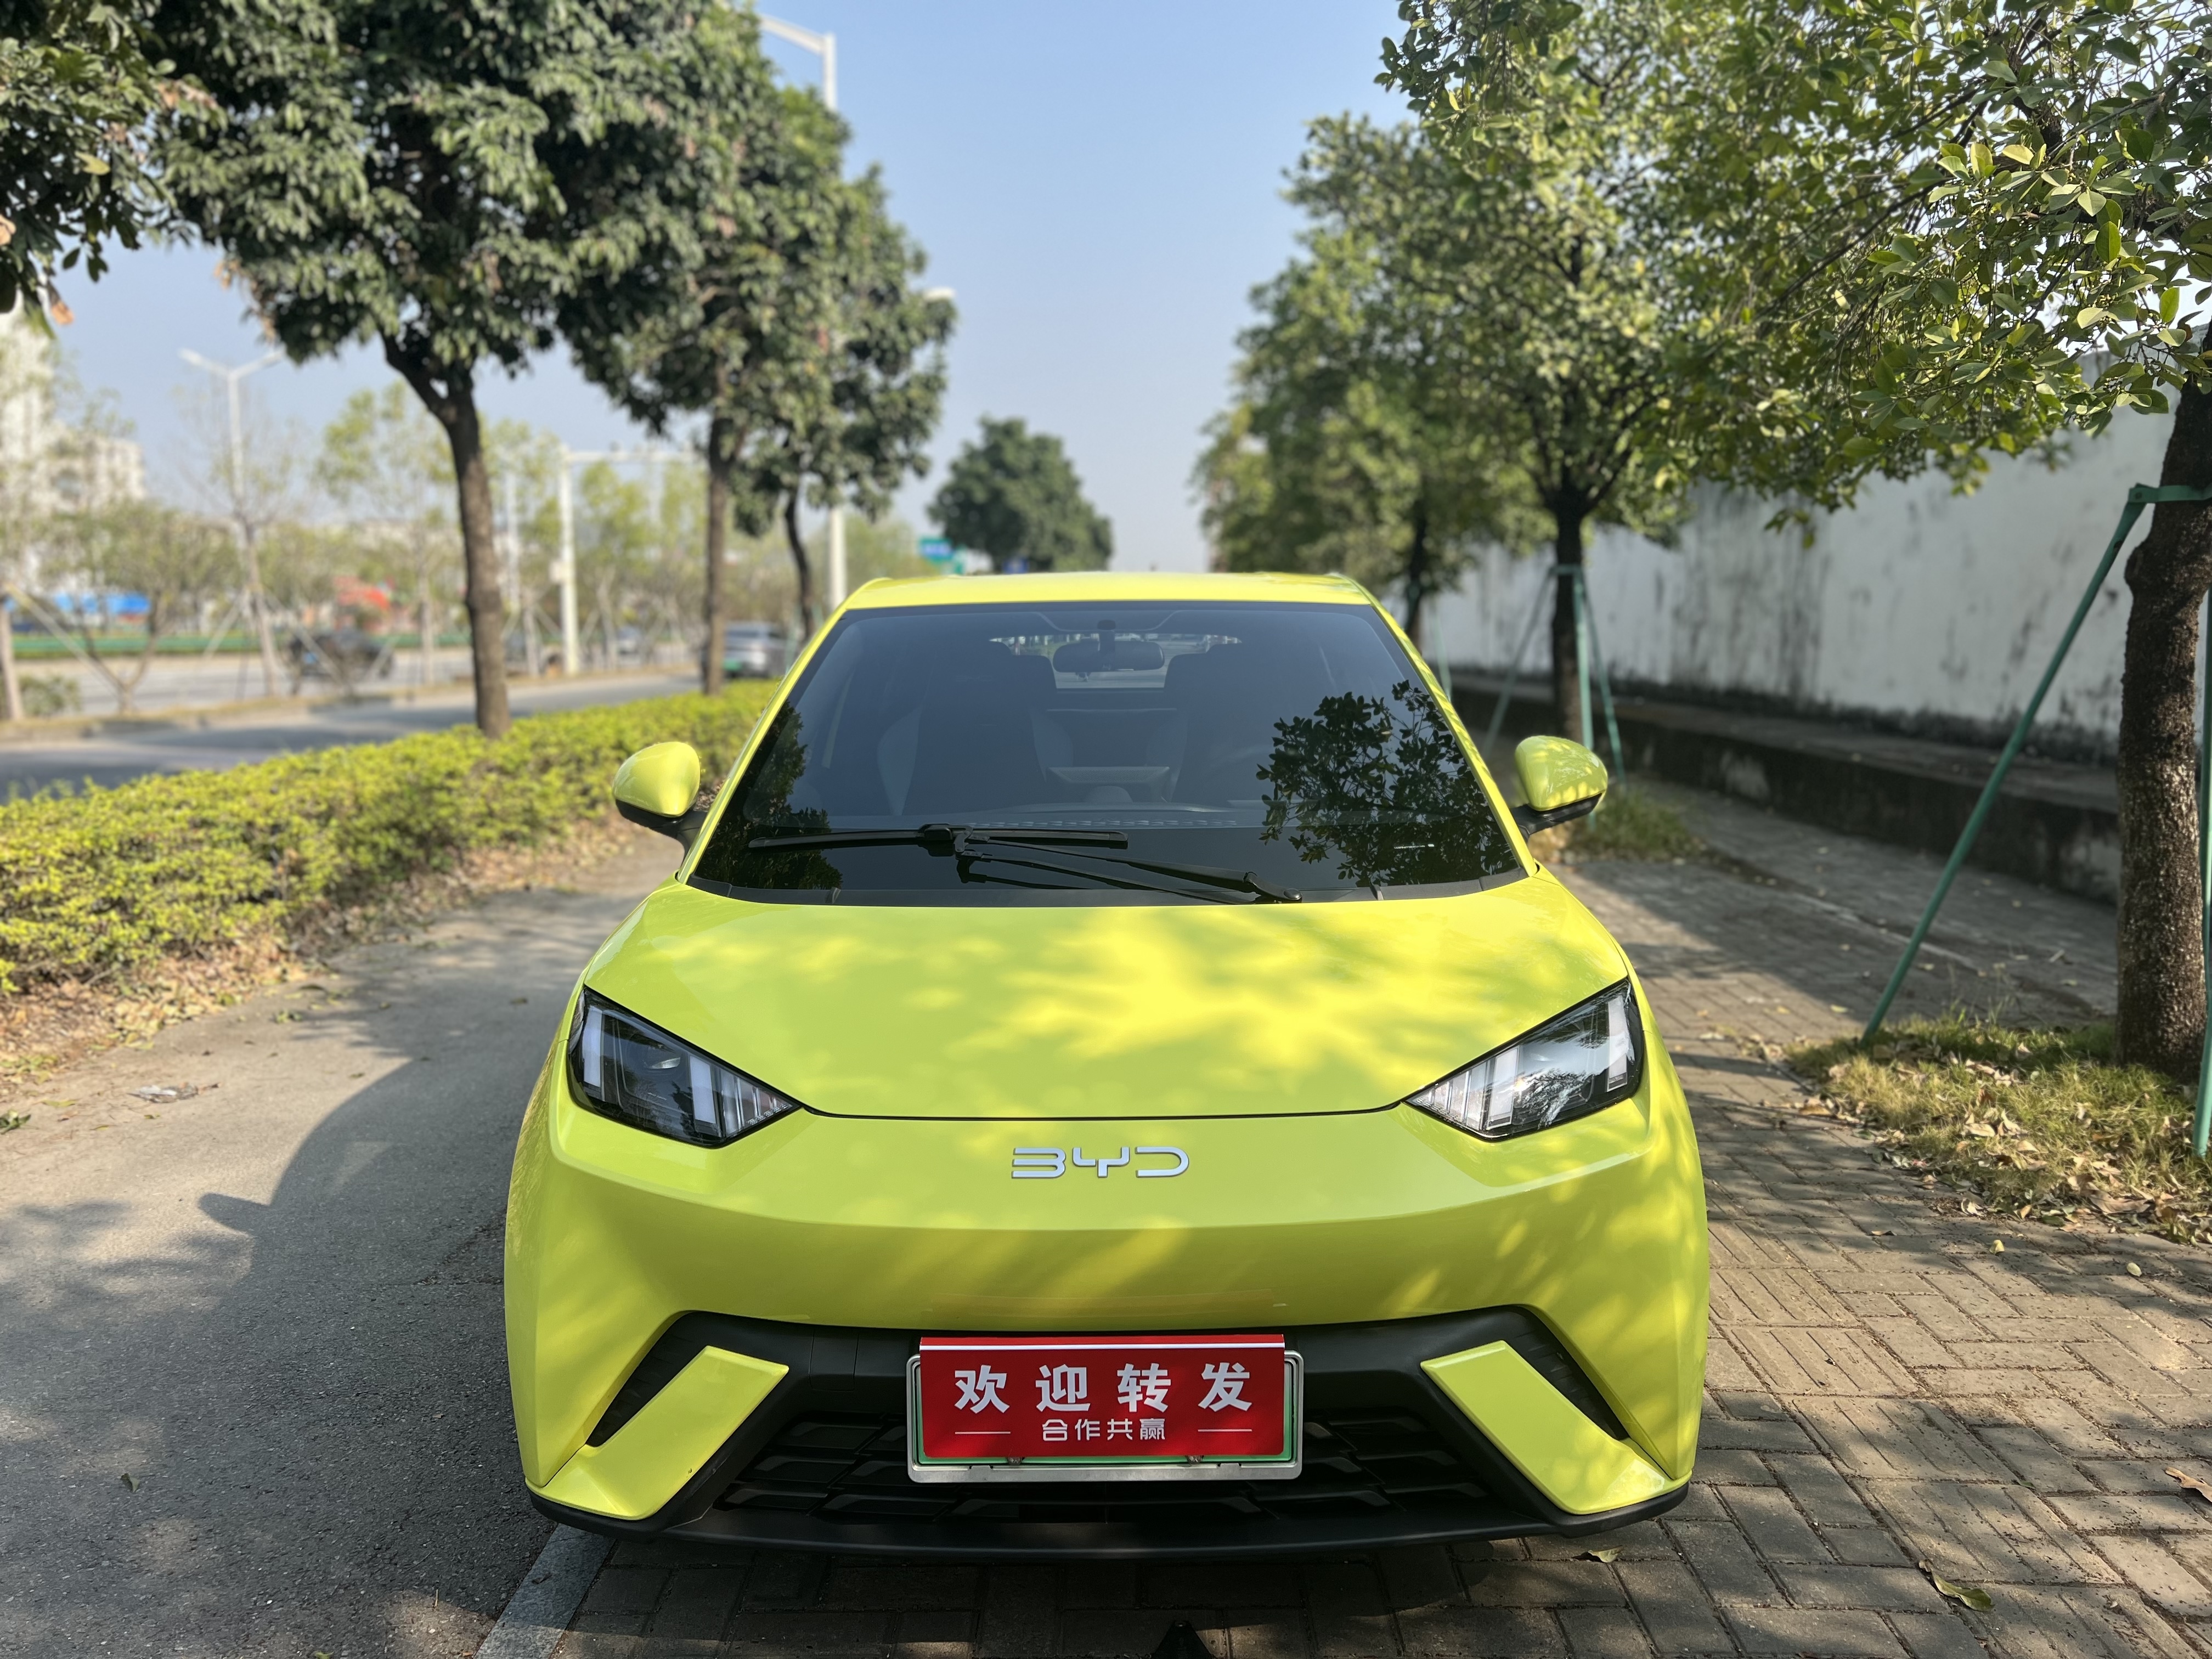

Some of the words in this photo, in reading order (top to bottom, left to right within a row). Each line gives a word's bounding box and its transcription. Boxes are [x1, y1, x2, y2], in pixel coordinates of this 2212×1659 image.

[1012, 1146, 1189, 1178] BYD
[955, 1362, 1252, 1414] 欢迎转发
[1042, 1418, 1165, 1441] 合作共赢
